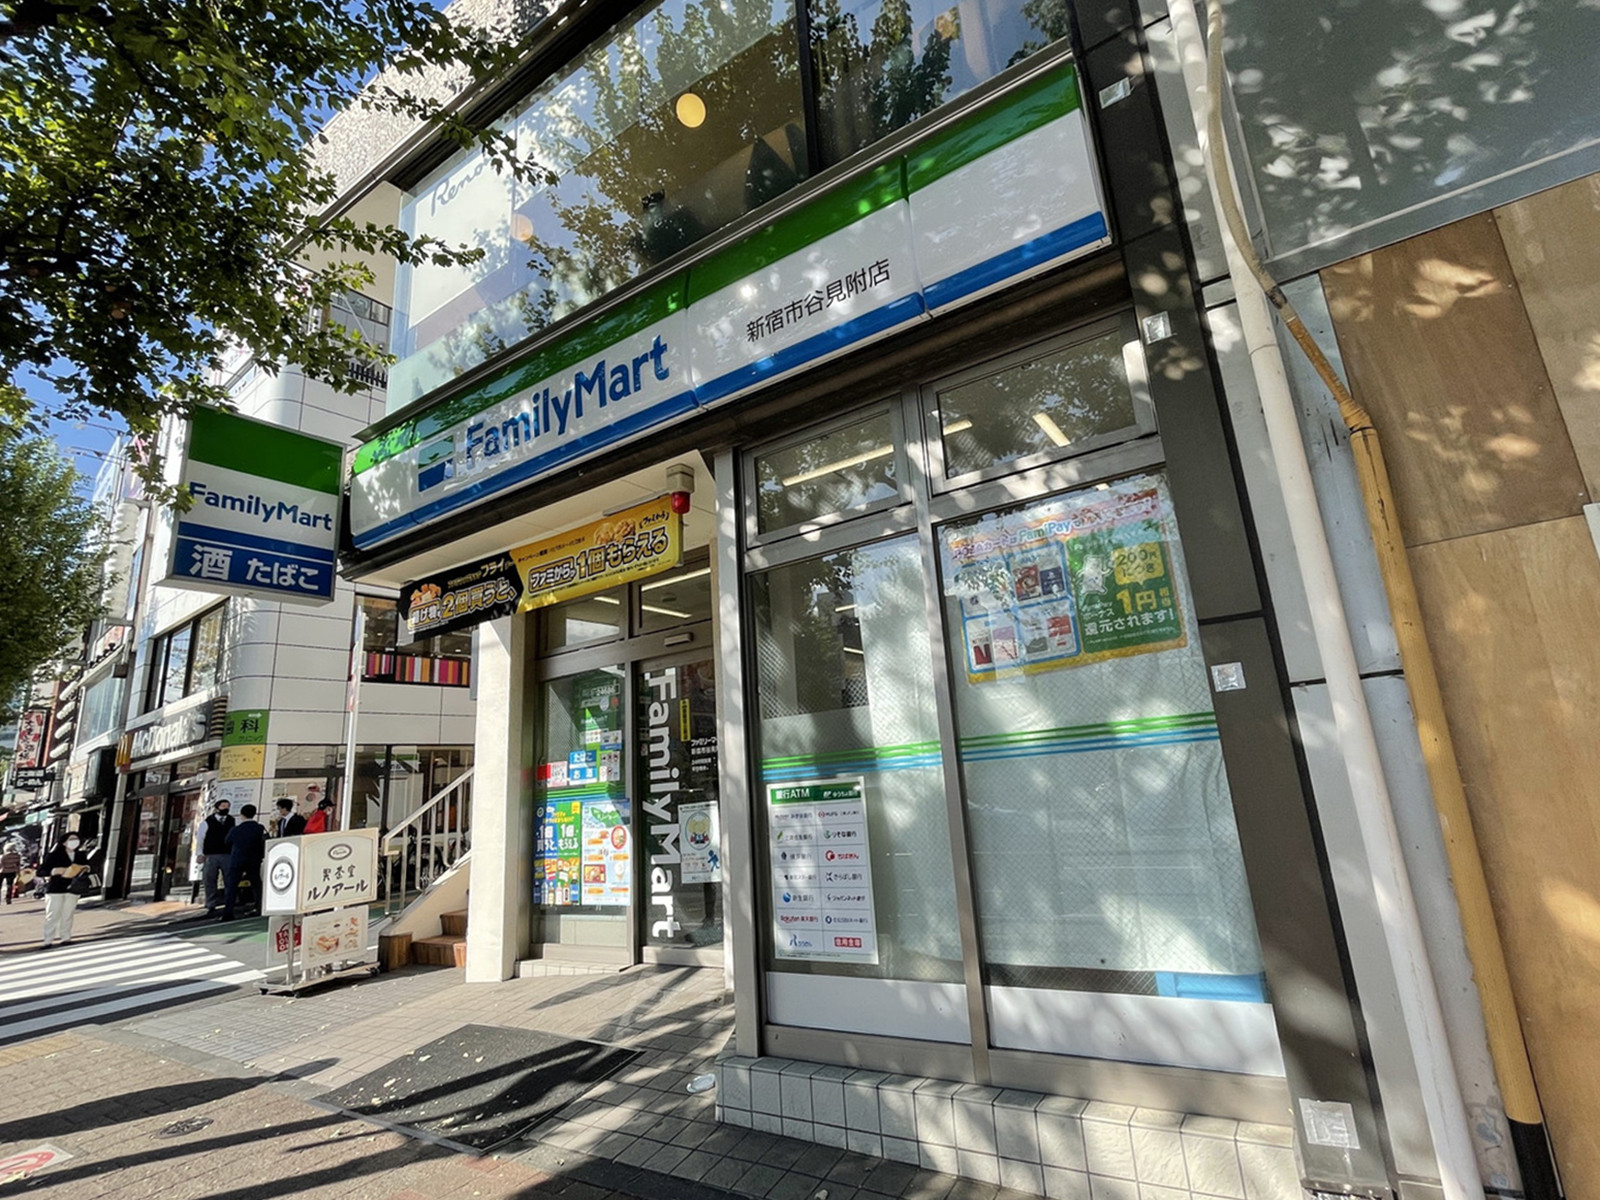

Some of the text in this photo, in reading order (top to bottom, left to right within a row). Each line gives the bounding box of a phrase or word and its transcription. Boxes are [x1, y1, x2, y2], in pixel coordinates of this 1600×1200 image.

[746, 258, 890, 343] 新宿市谷見附店
[466, 335, 671, 470] FamilyMart
[189, 481, 333, 532] FamilyMart
[577, 527, 669, 579] 1個もらえる
[1018, 520, 1074, 546] FamiPay
[189, 544, 320, 591] 酒 たばこ
[1084, 609, 1175, 636] 還元されます!
[1116, 588, 1158, 615] 1円
[643, 666, 682, 939] FamilyMart
[307, 879, 369, 901] ルノアール
